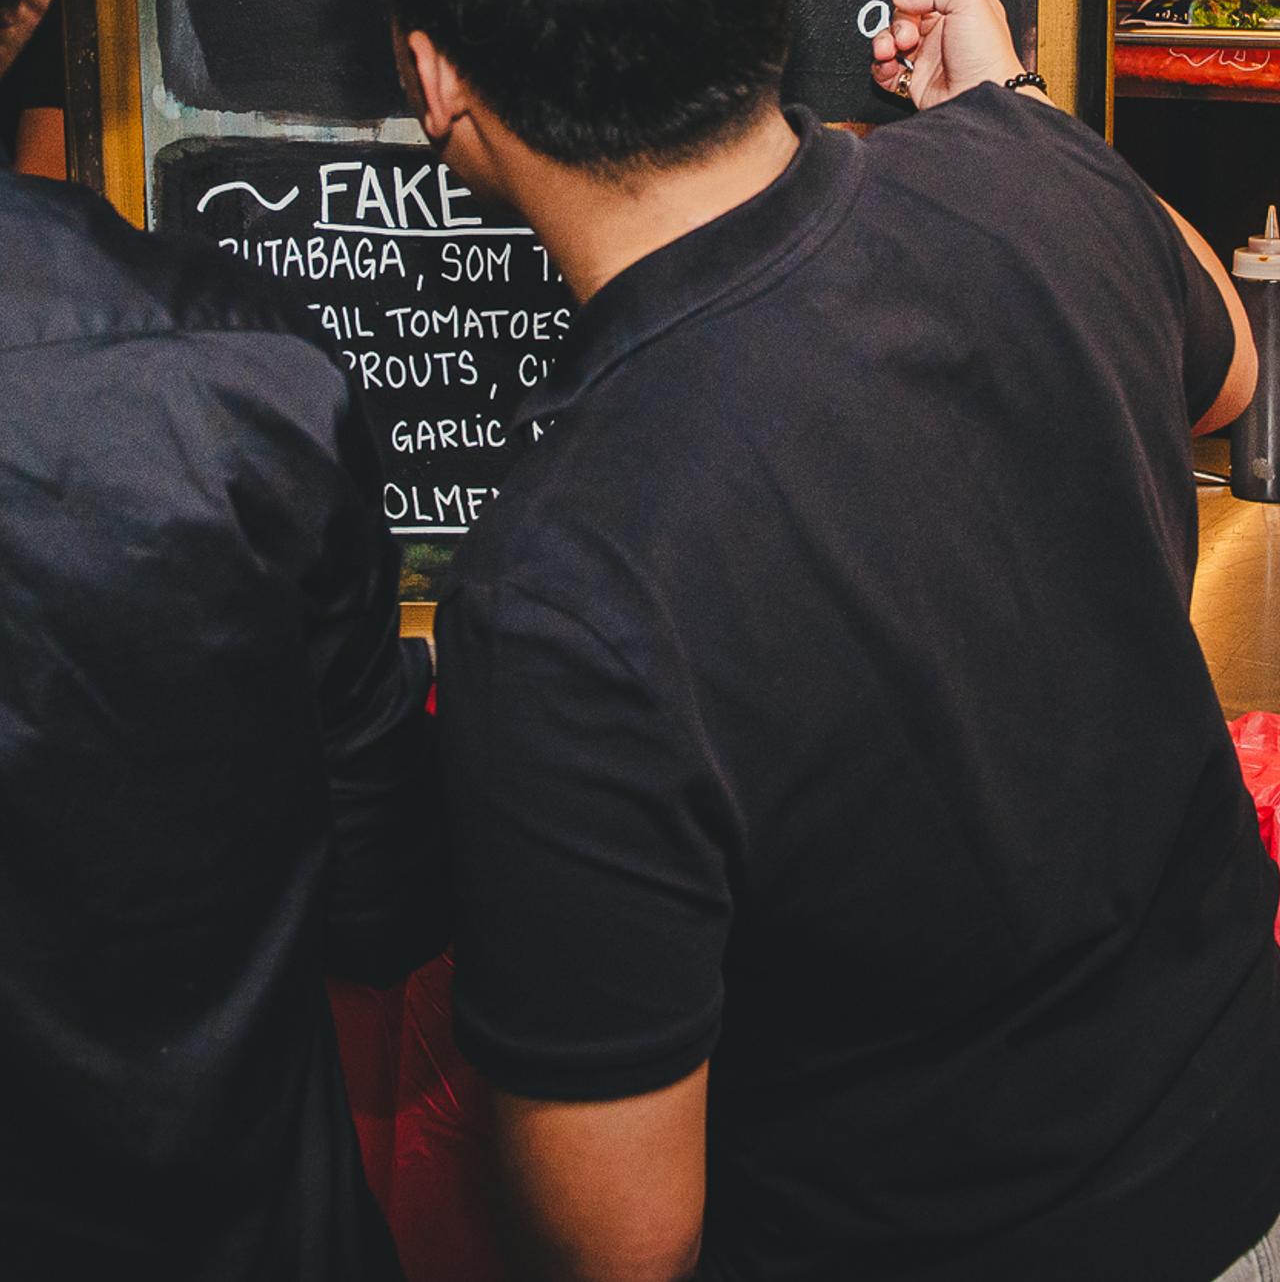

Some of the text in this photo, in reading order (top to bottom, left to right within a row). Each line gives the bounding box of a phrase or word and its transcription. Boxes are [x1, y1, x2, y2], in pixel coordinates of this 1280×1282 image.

[319, 161, 483, 229] FAKE
[441, 242, 512, 282] SOM
[392, 413, 506, 454] GARLIC
